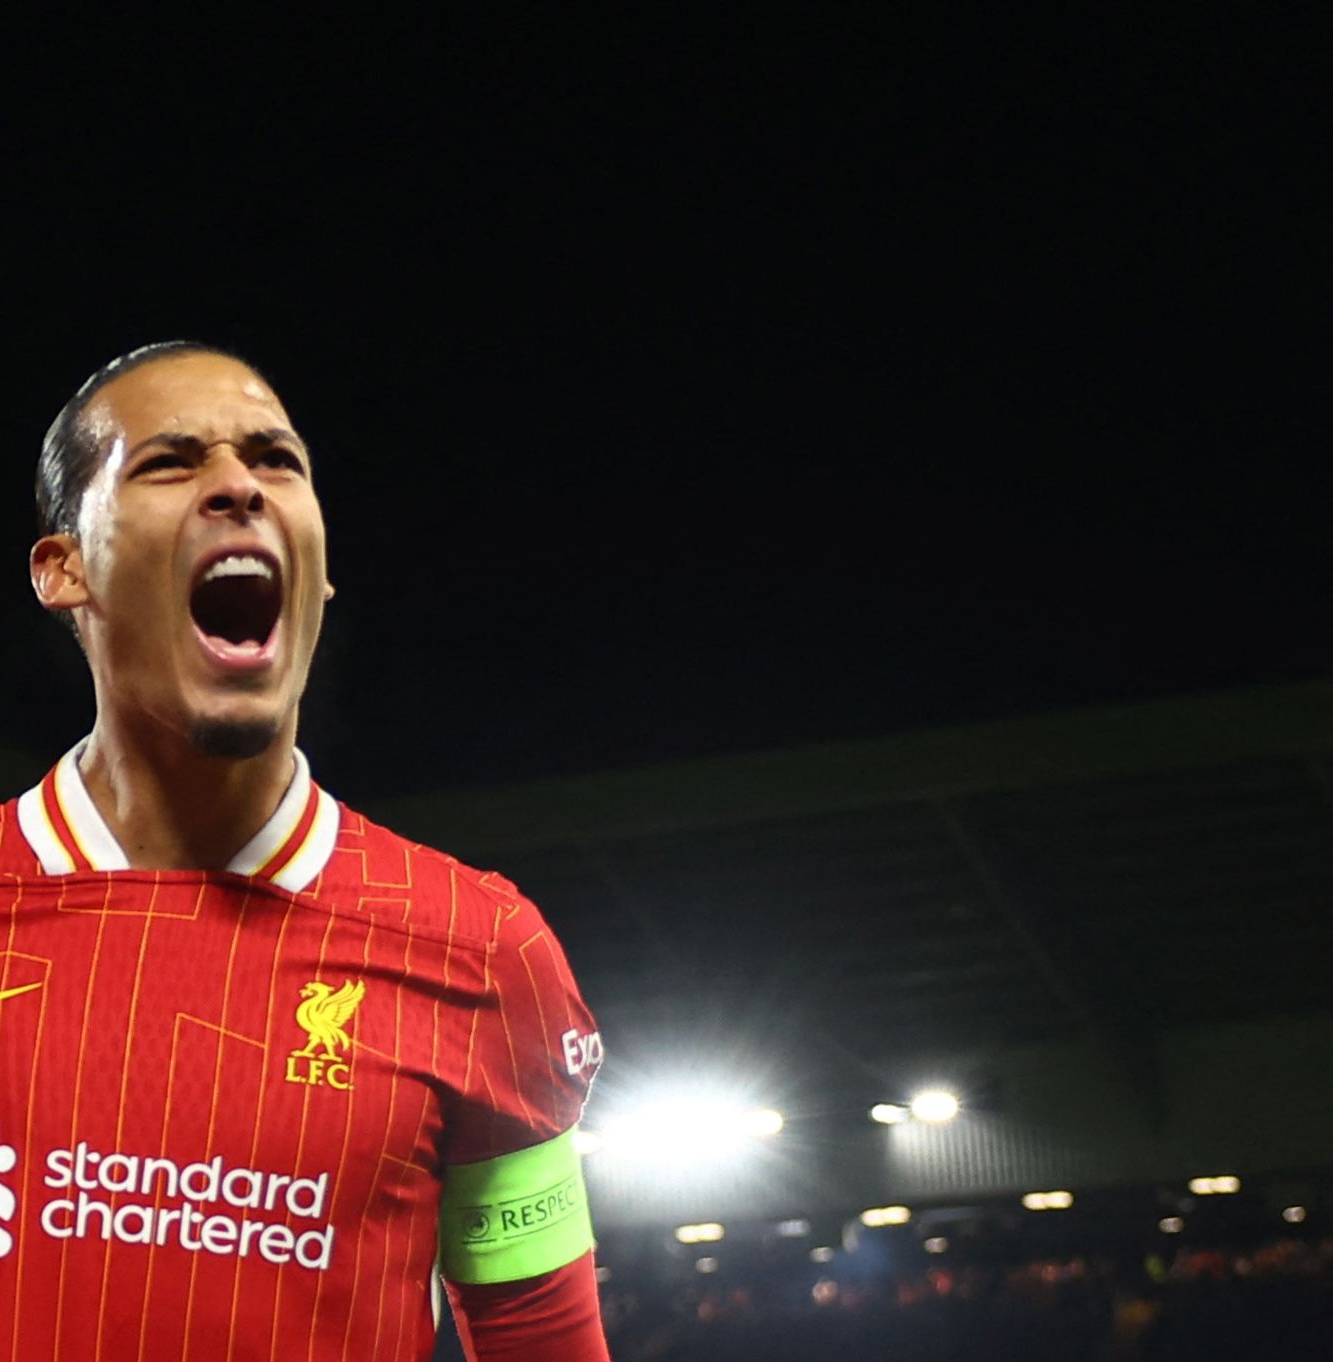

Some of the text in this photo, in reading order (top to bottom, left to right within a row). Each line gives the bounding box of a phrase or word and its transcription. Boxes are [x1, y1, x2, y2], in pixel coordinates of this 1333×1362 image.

[44, 1142, 329, 1219] standard
[501, 1181, 579, 1232] RESPEC
[41, 1191, 335, 1271] chartered
